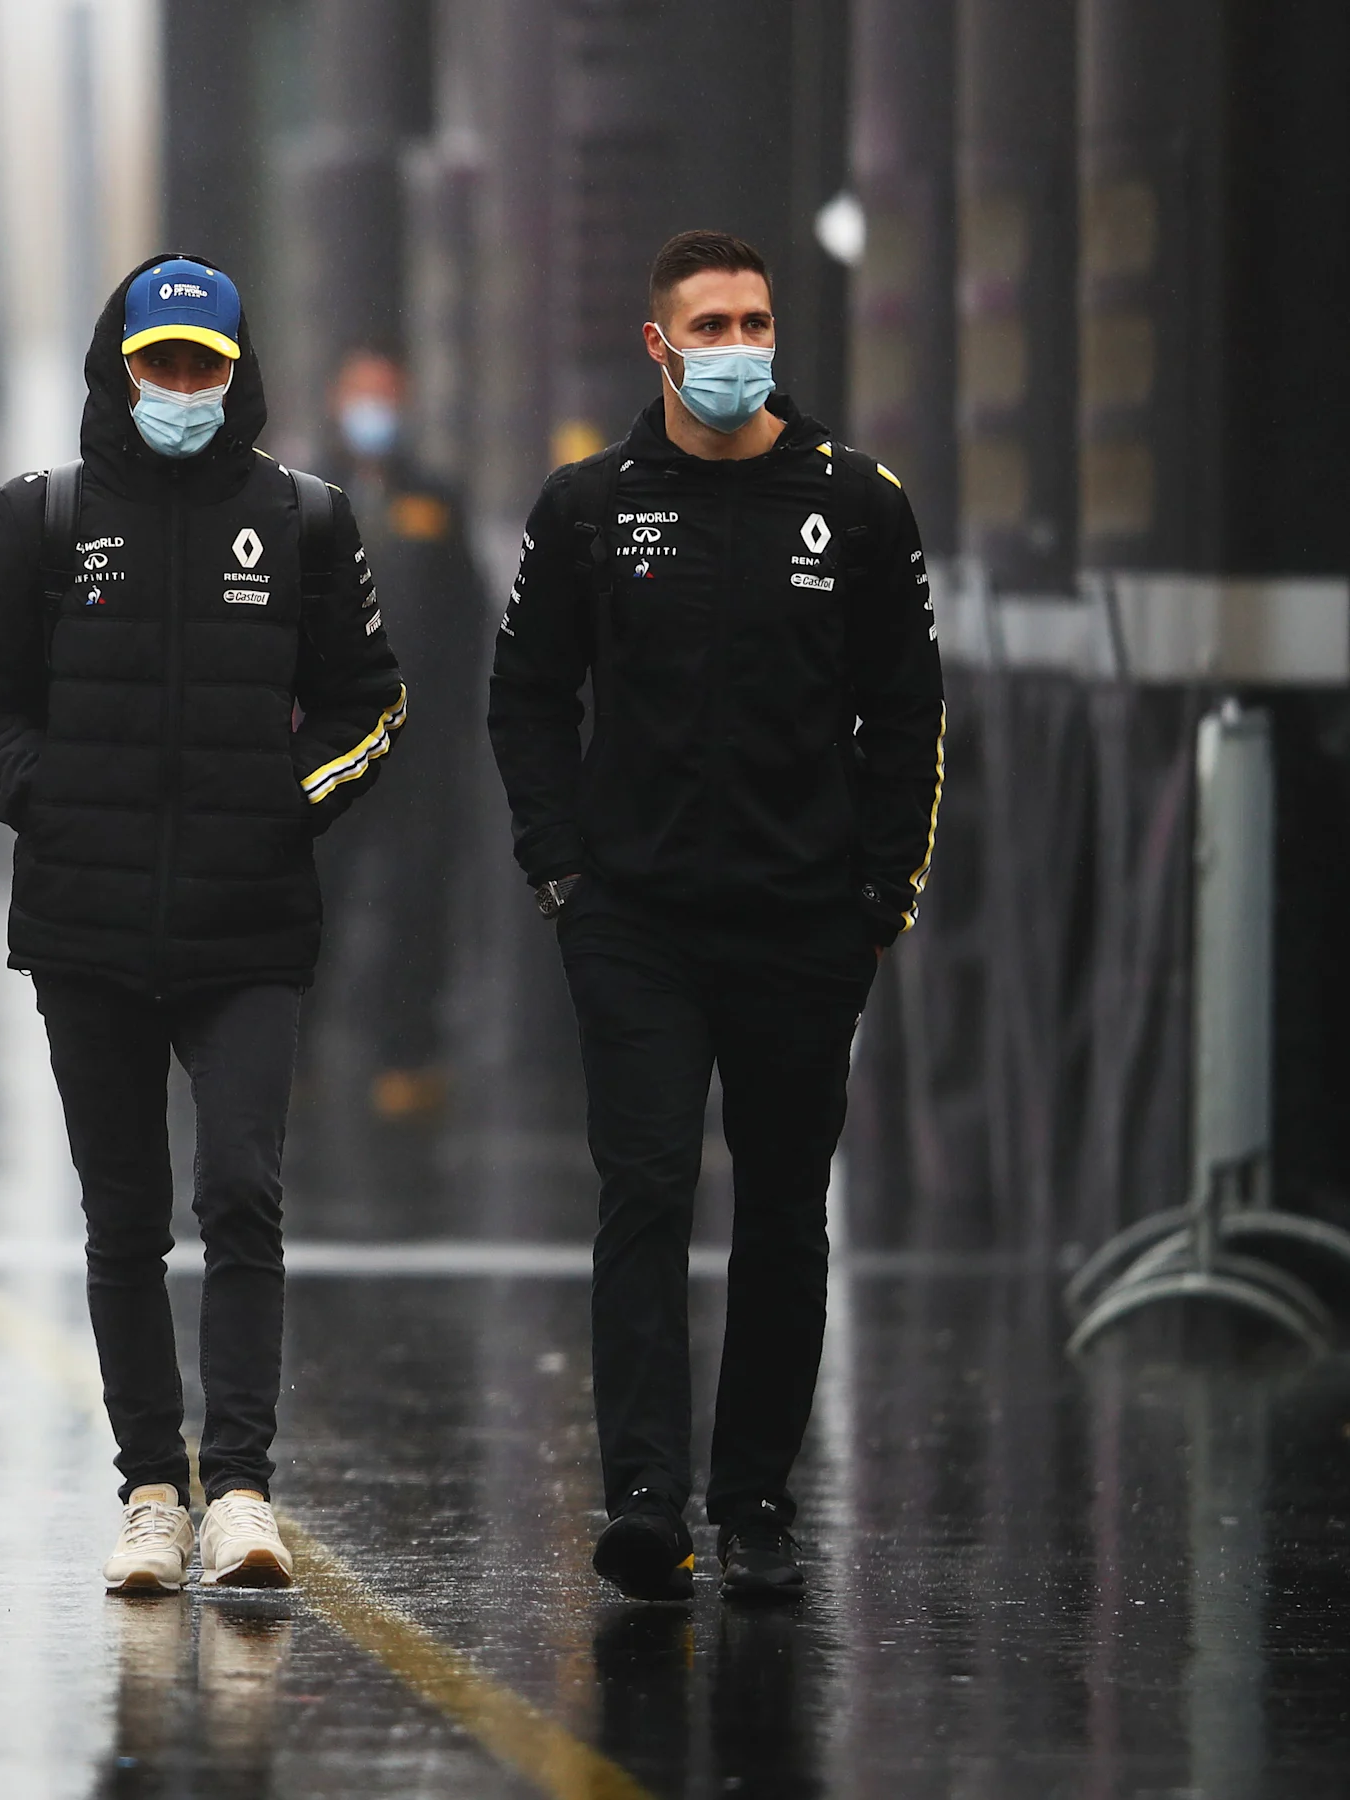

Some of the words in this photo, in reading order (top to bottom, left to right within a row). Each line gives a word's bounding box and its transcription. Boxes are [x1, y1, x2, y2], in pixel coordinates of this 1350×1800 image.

[617, 513, 635, 525] DP
[635, 511, 679, 524] WORLD
[85, 536, 125, 552] WORLD
[616, 546, 677, 556] INFINITI
[791, 555, 821, 566] RENA
[74, 571, 126, 584] INFINITI
[223, 572, 271, 584] RENAULT
[235, 591, 266, 604] Castrol
